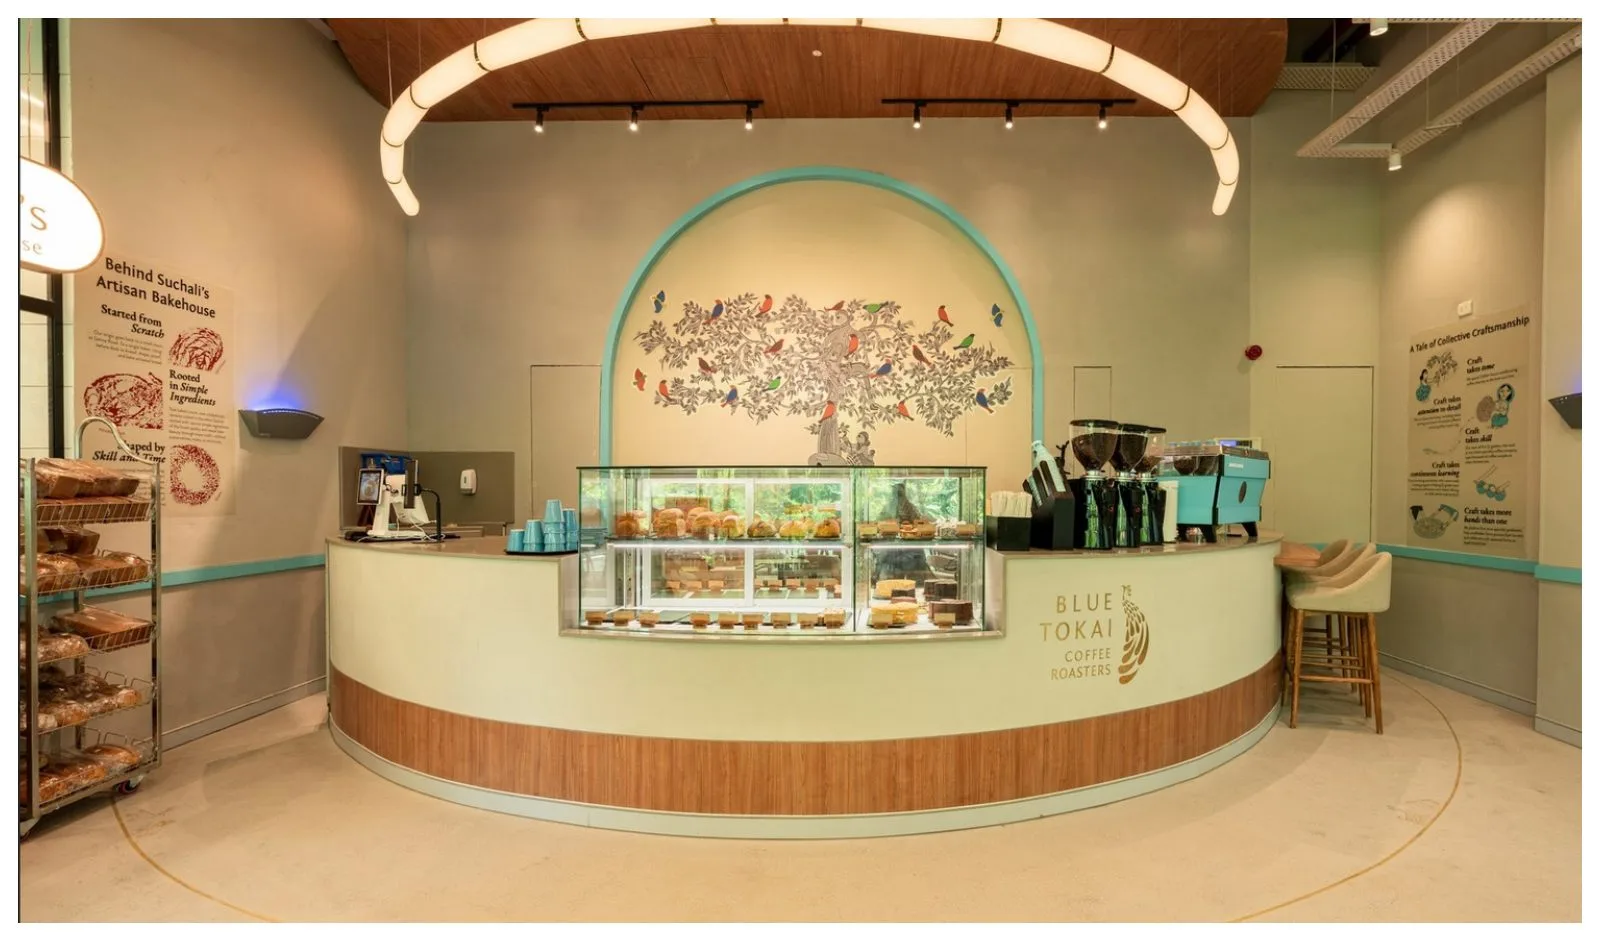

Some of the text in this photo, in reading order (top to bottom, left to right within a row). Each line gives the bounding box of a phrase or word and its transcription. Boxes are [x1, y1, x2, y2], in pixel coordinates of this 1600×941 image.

[105, 257, 210, 299] Behind Suchali's
[96, 275, 216, 318] Artisan Bakehouse
[101, 304, 162, 327] Started from
[131, 323, 165, 339] Scratch
[1410, 315, 1530, 353] A Tale of Collective Craftsmanship
[1467, 356, 1483, 365] Craft
[169, 369, 201, 383] Rooted
[169, 382, 209, 398] in Simple
[169, 391, 216, 407] Ingredients
[1465, 427, 1480, 435] Craft
[92, 450, 118, 461] Skill
[154, 442, 166, 454] by
[1464, 507, 1479, 515] Craft
[1481, 516, 1495, 524] than
[1057, 592, 1112, 613] BLUE
[1039, 618, 1112, 642] TOKAI
[1065, 647, 1112, 663] COFFEE
[1051, 664, 1112, 681] ROASTERS
